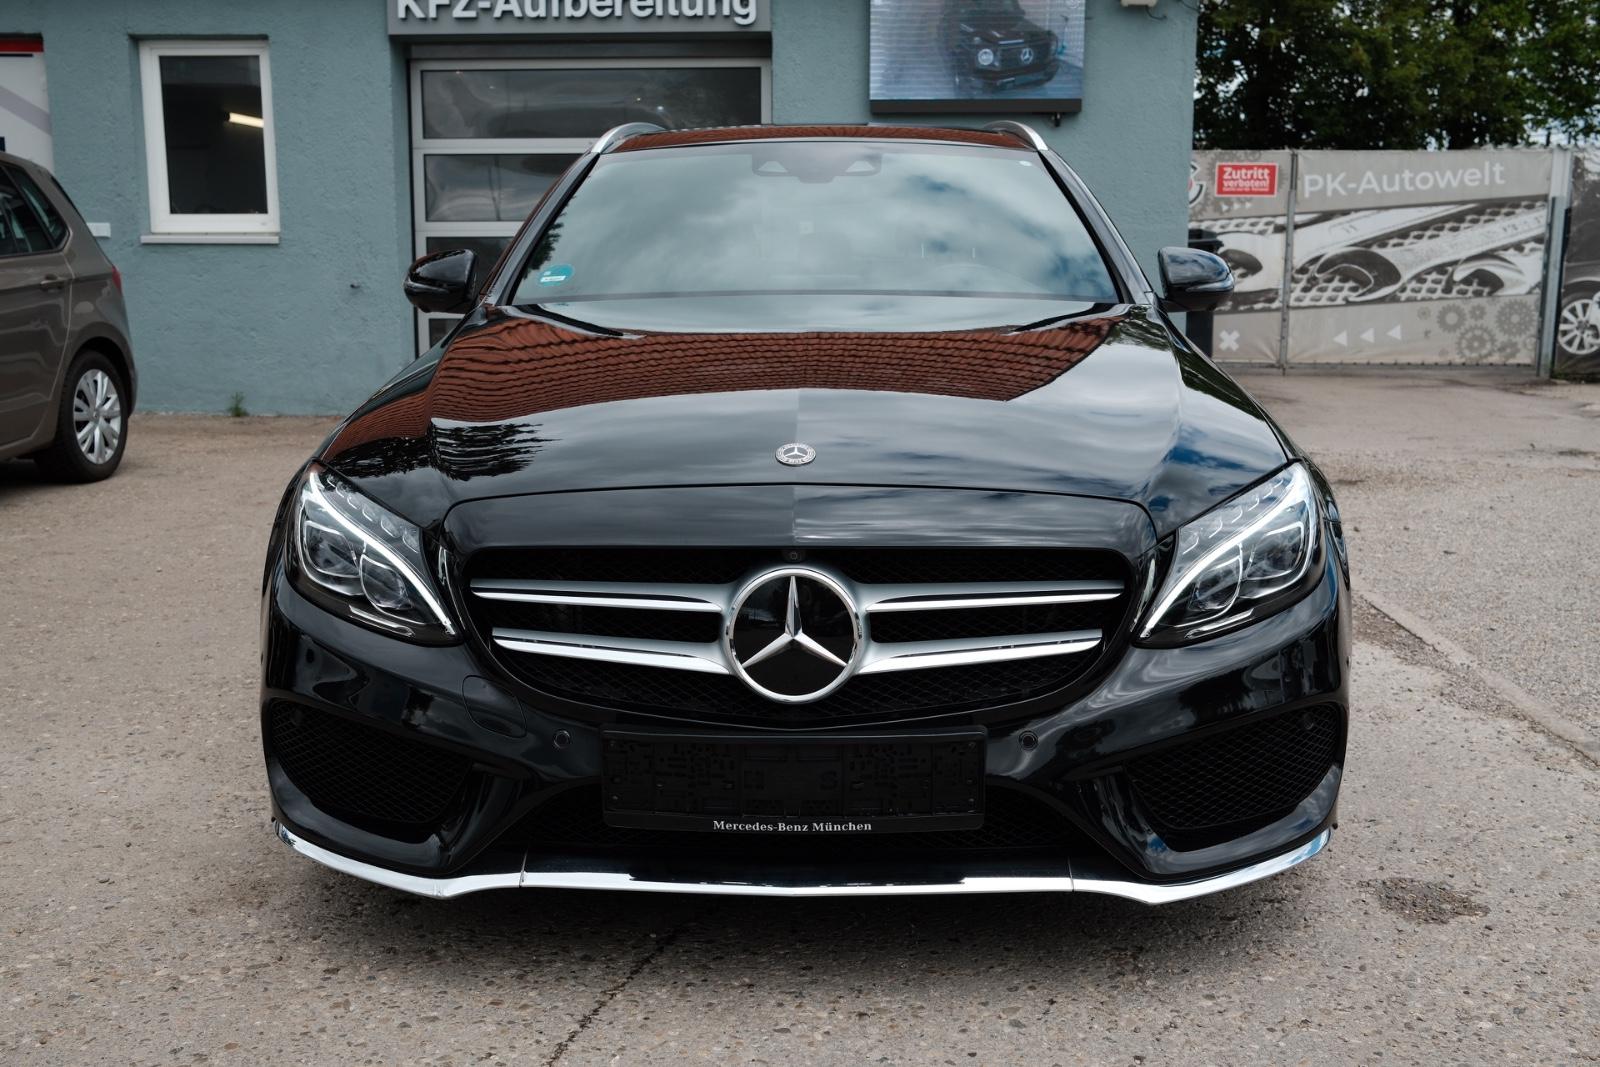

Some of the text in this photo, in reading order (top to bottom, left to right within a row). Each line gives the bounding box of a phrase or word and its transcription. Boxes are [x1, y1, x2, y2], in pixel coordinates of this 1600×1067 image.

[1223, 167, 1270, 180] Zutritt
[1303, 160, 1506, 198] PK-Autowelt
[1223, 179, 1269, 187] verboten!
[713, 820, 872, 832] Mercedes-Benz München
